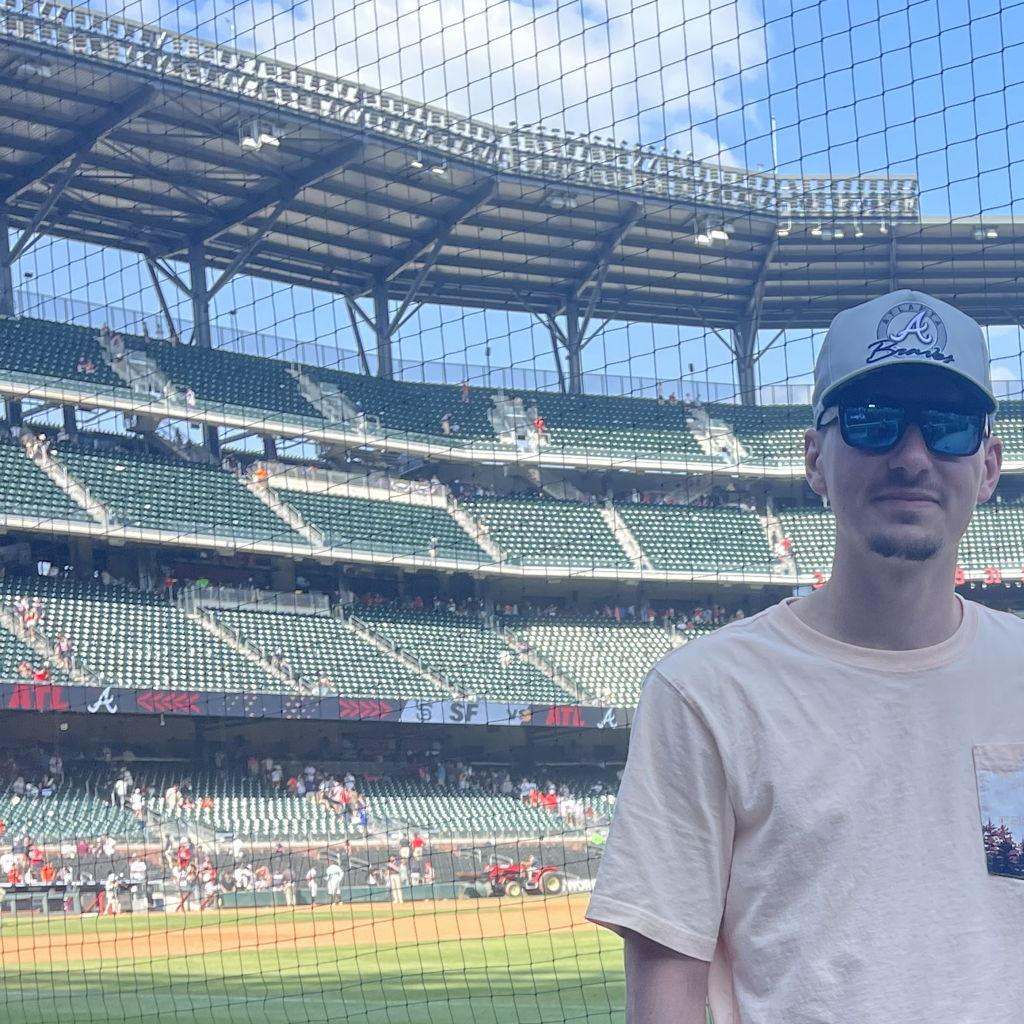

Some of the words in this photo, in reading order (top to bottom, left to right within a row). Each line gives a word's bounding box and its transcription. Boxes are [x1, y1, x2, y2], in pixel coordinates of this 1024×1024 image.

[890, 309, 933, 343] A
[866, 339, 956, 364] Braves
[9, 685, 69, 711] ATL
[87, 686, 118, 714] A
[449, 703, 479, 722] SF
[546, 705, 585, 728] ATL
[596, 708, 618, 729] A
